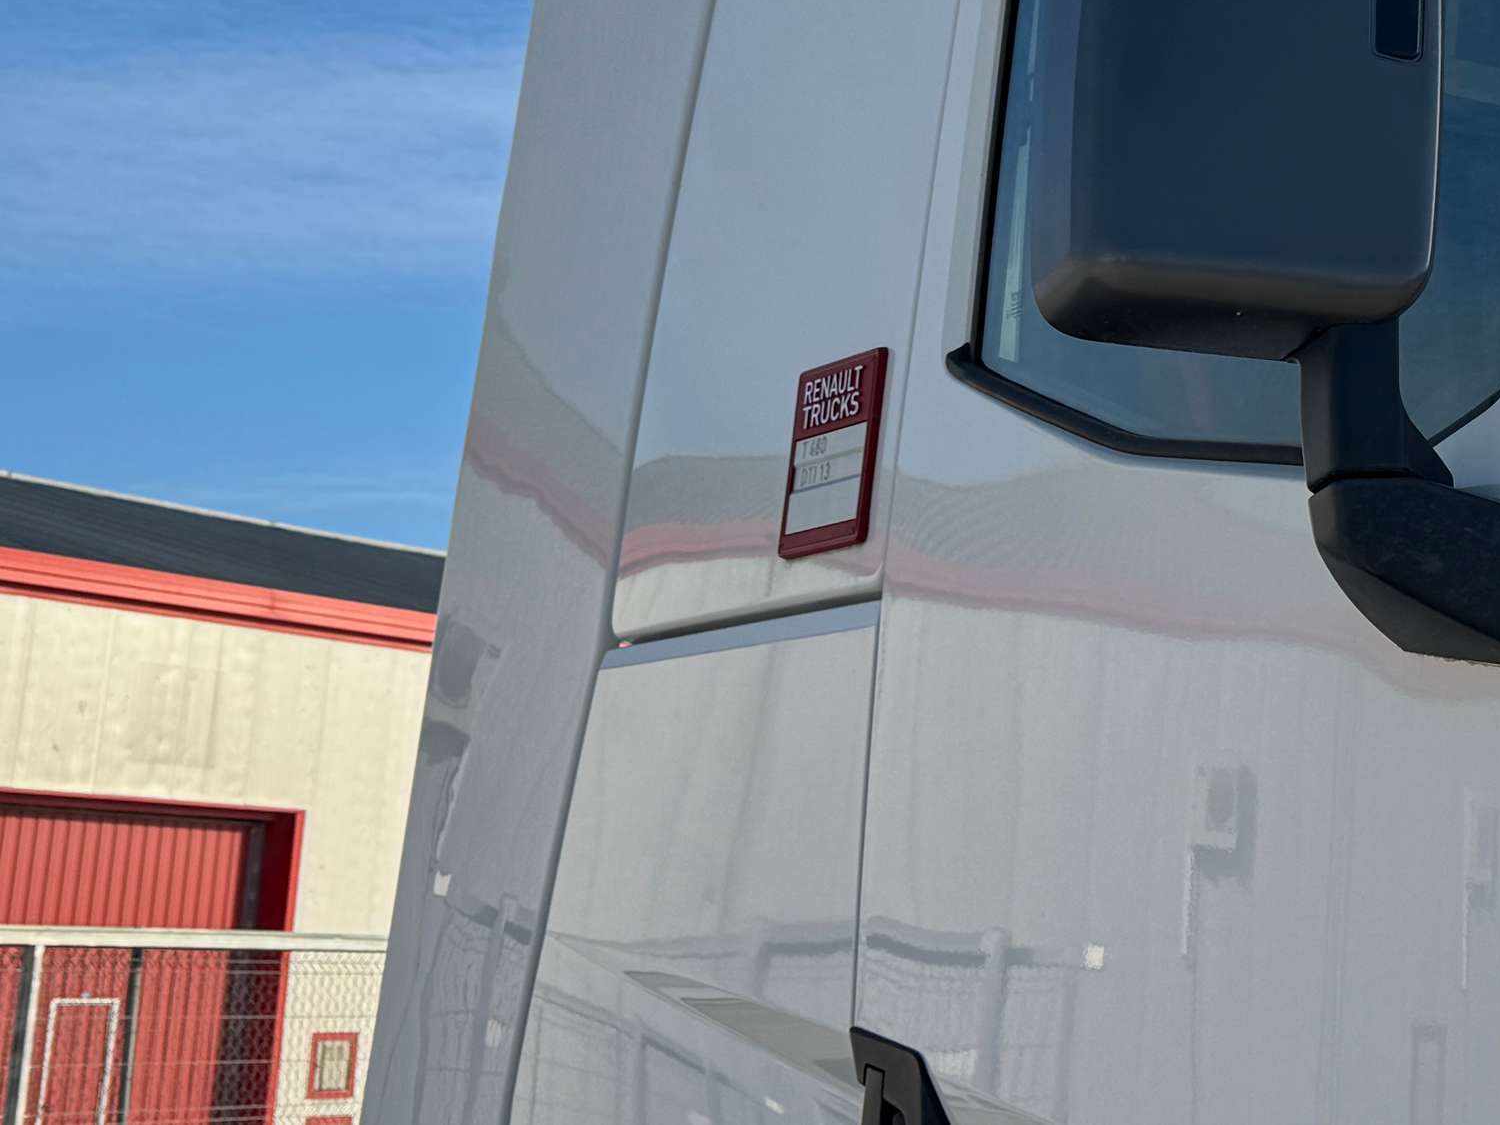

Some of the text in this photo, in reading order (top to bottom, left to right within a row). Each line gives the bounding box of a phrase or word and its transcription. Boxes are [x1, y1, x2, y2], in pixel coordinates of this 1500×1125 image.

[803, 365, 863, 405] RENAULT
[802, 391, 860, 429] TRUCKS
[800, 461, 831, 487] DTI 13
